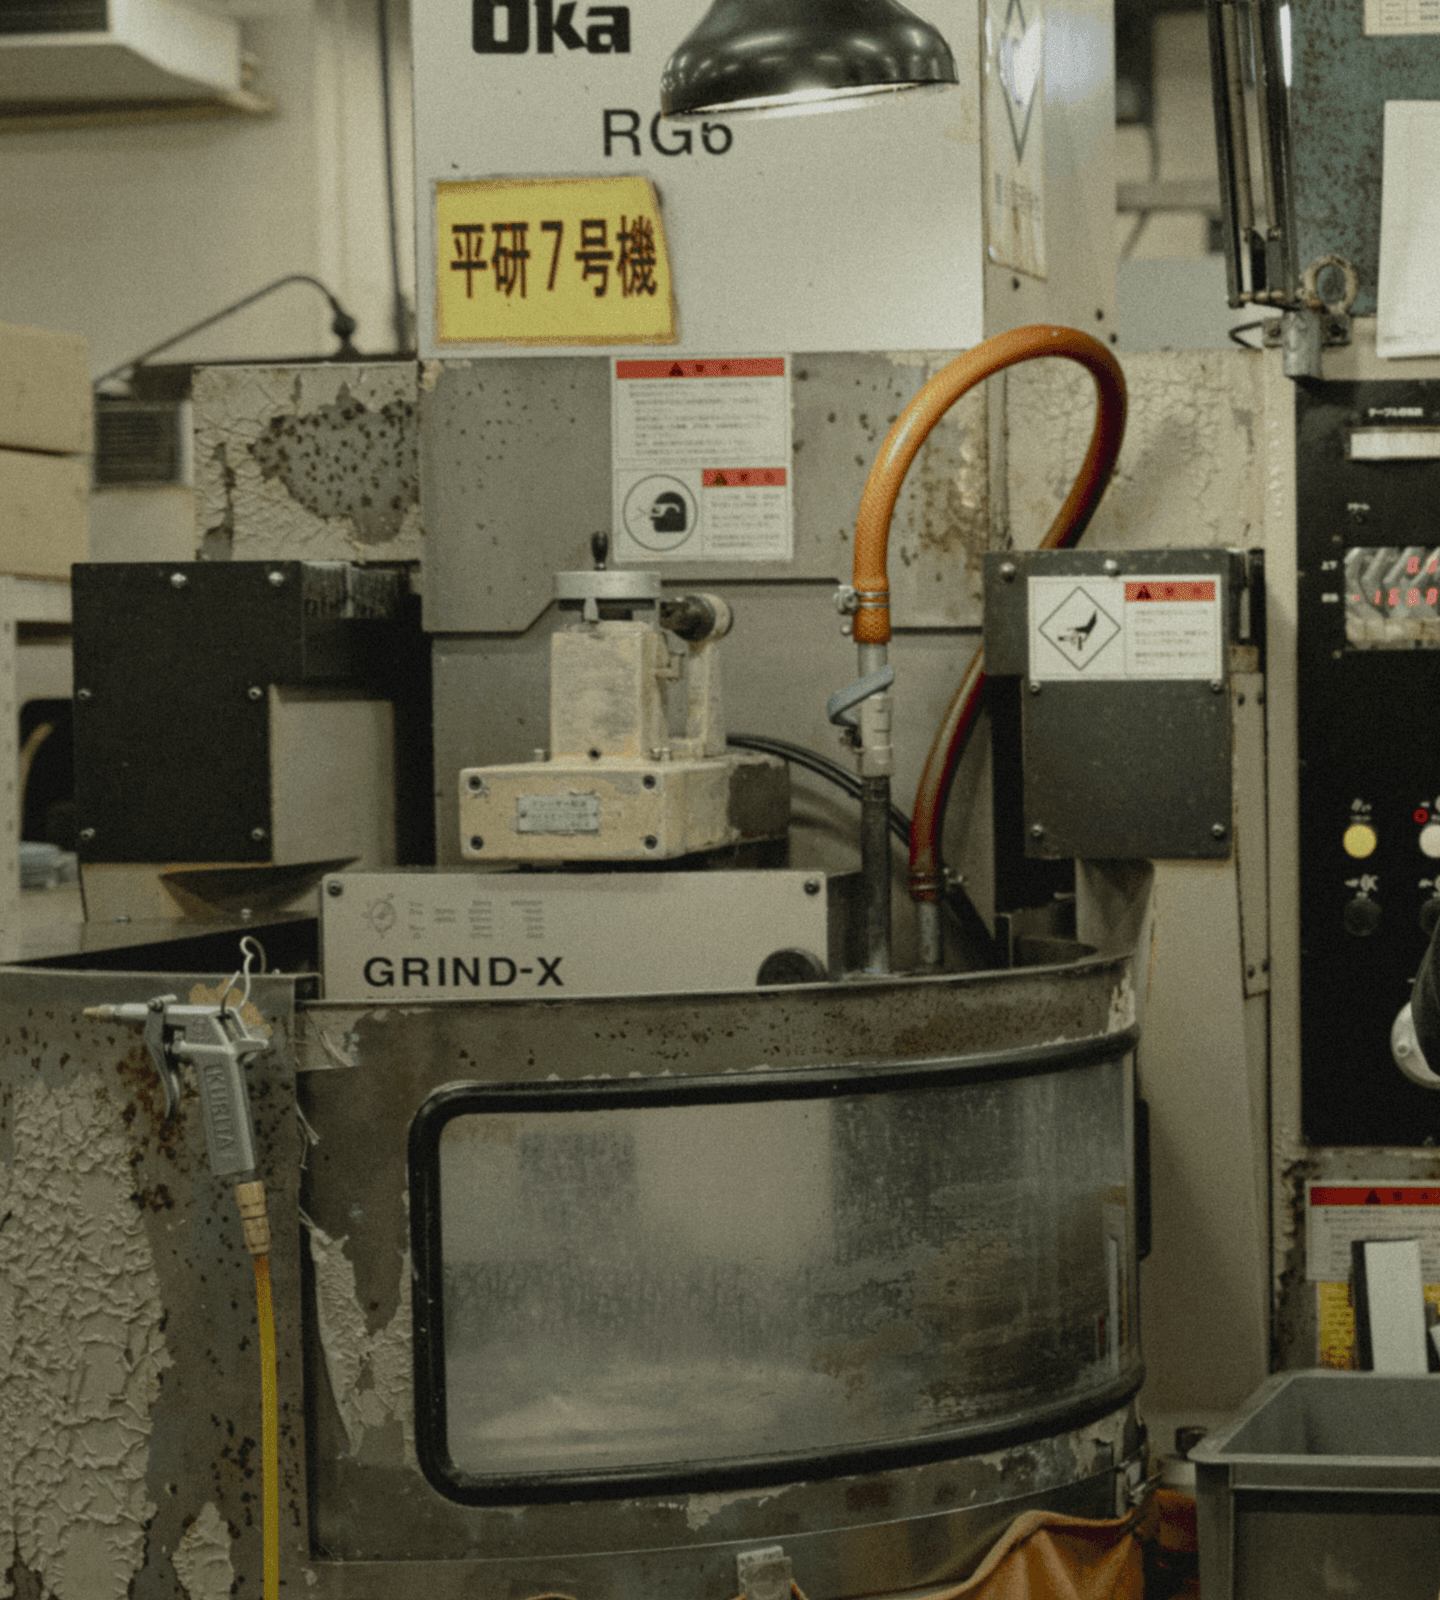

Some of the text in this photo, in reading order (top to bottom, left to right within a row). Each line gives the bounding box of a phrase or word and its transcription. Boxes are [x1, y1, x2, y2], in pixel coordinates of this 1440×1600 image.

[450, 214, 658, 299] 平研7号機
[362, 956, 566, 988] GRIND-X
[205, 1069, 238, 1150] KURITA
